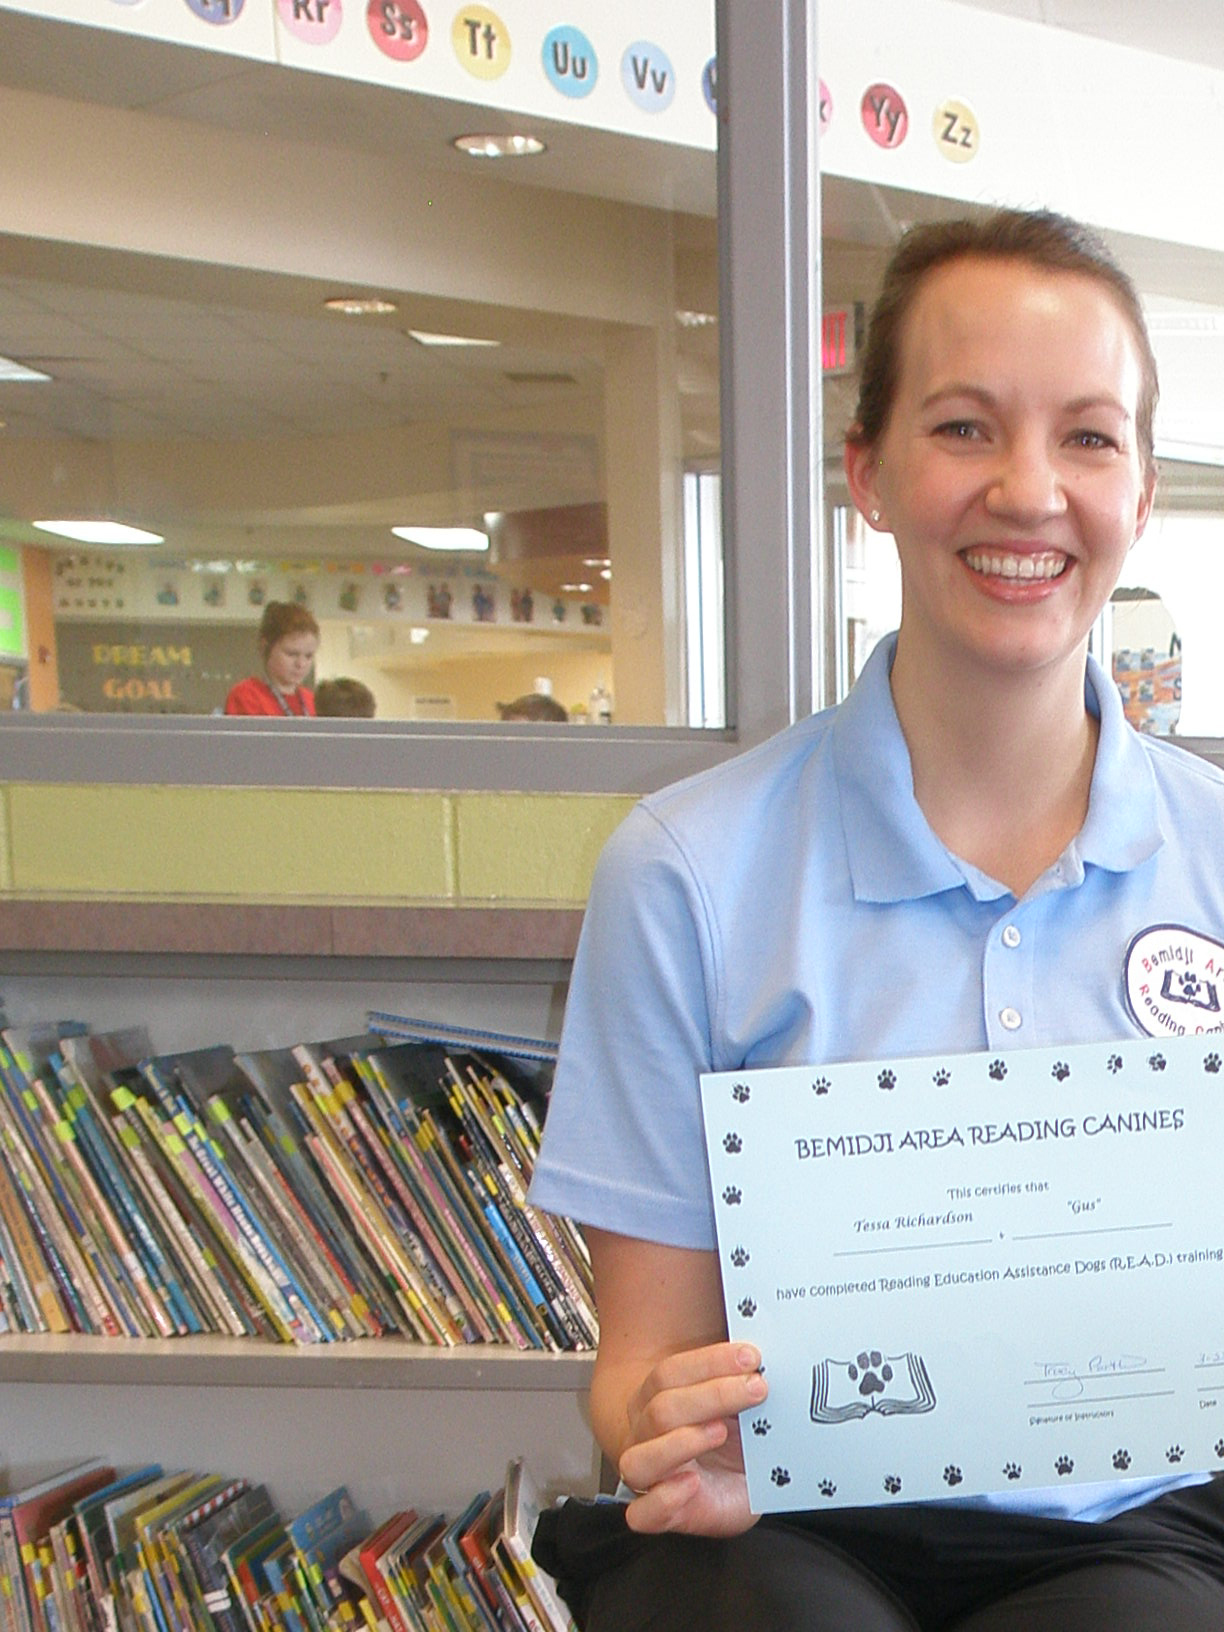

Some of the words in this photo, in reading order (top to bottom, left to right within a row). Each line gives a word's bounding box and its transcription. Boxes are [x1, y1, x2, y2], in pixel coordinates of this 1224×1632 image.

[378, 2, 413, 41] Ss
[464, 17, 496, 60] Tt
[552, 41, 587, 80] Uu
[632, 55, 667, 94] Vv
[870, 94, 901, 143] Yy
[941, 111, 973, 148] Zz
[93, 644, 192, 667] DREAM
[103, 677, 176, 700] GOAL
[1141, 946, 1194, 974] Bemidji
[1139, 984, 1186, 1036] Reading
[794, 1131, 894, 1160] BEMIDJI
[899, 1126, 965, 1151] AREA
[967, 1118, 1077, 1146] READING
[1082, 1108, 1185, 1136] CANINES
[946, 1187, 972, 1201] This
[1025, 1180, 1049, 1193] that
[1067, 1197, 1101, 1215] "Gus"
[853, 1218, 890, 1234] Tessa
[894, 1210, 974, 1230] Richardson
[776, 1287, 806, 1301] have
[809, 1280, 876, 1298] completed
[878, 1274, 930, 1293] Reading
[934, 1269, 1000, 1287] Education
[1003, 1262, 1071, 1281] Assistance
[1075, 1259, 1106, 1276] Dogs
[1199, 1399, 1217, 1410] Date
